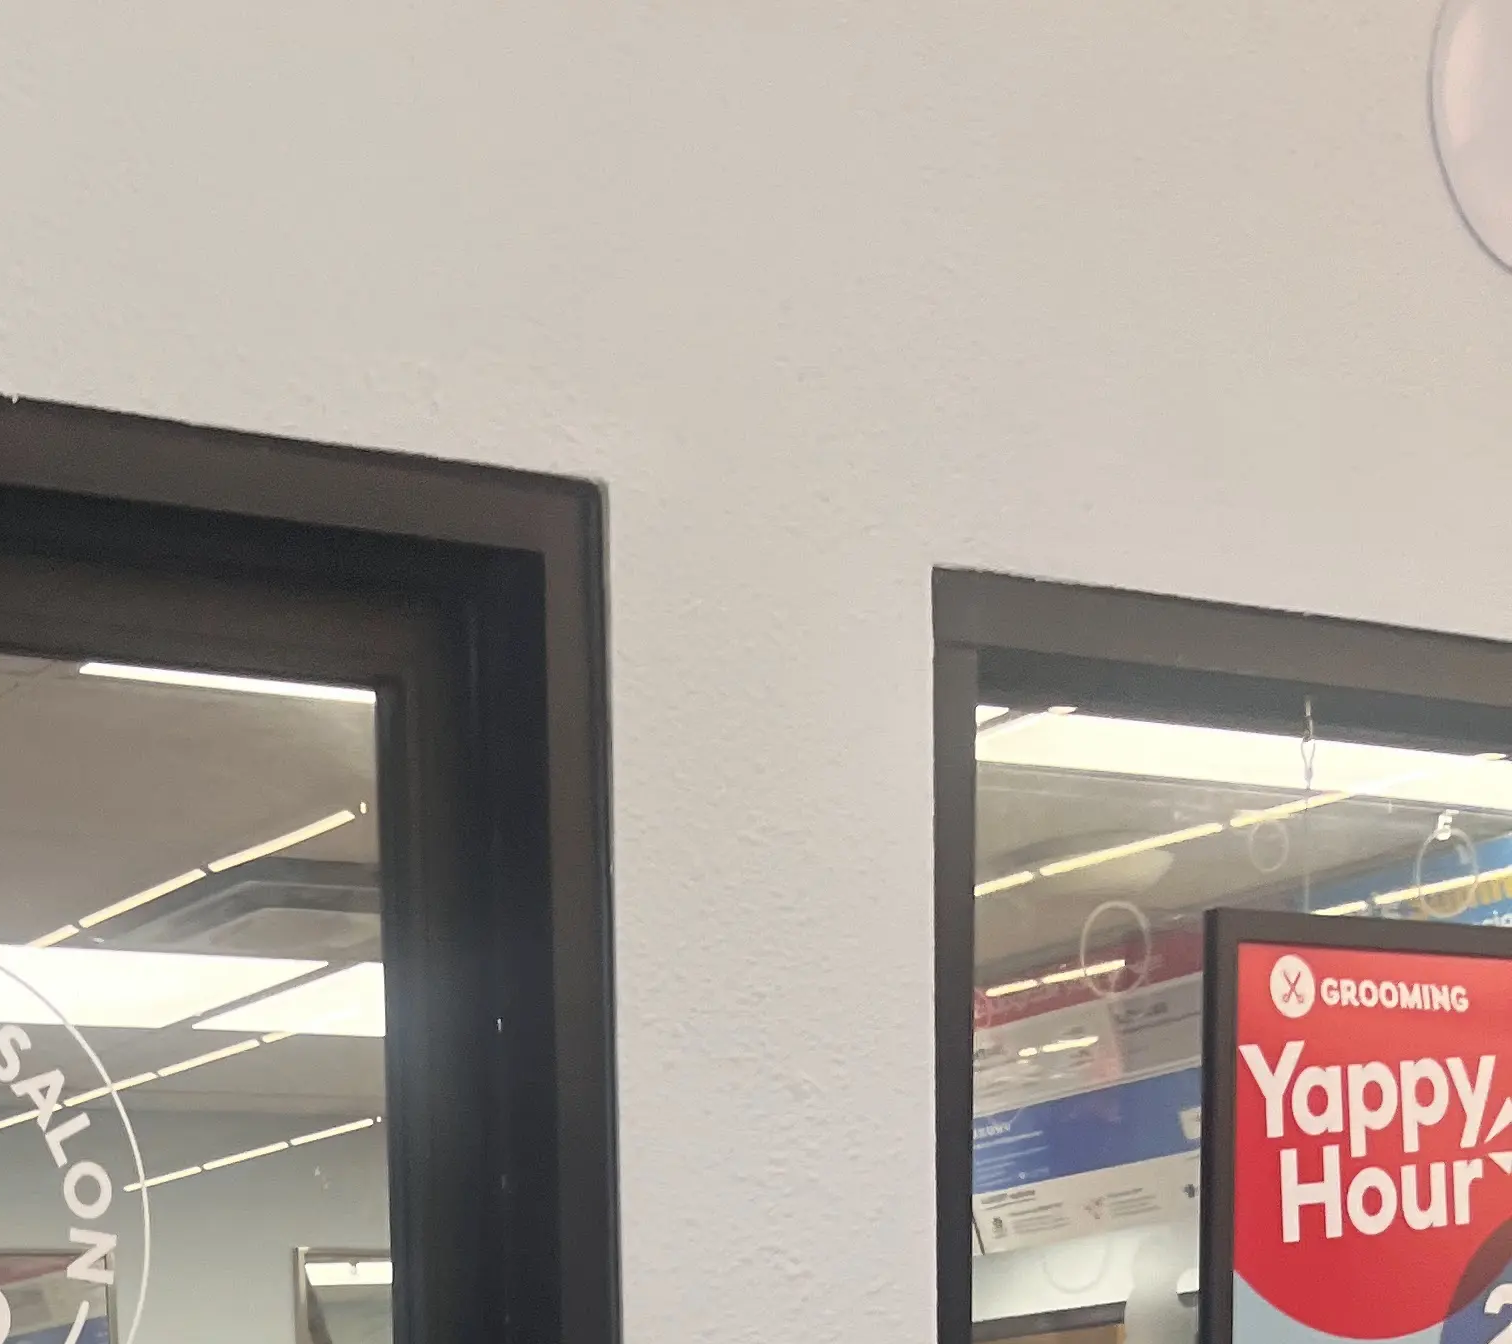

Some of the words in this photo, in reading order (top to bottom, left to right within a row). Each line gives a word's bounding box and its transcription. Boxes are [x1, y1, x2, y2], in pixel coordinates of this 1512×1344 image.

[1320, 977, 1470, 1013] GROOMING
[1238, 1039, 1496, 1158] Yappy
[1279, 1143, 1483, 1243] Hour
